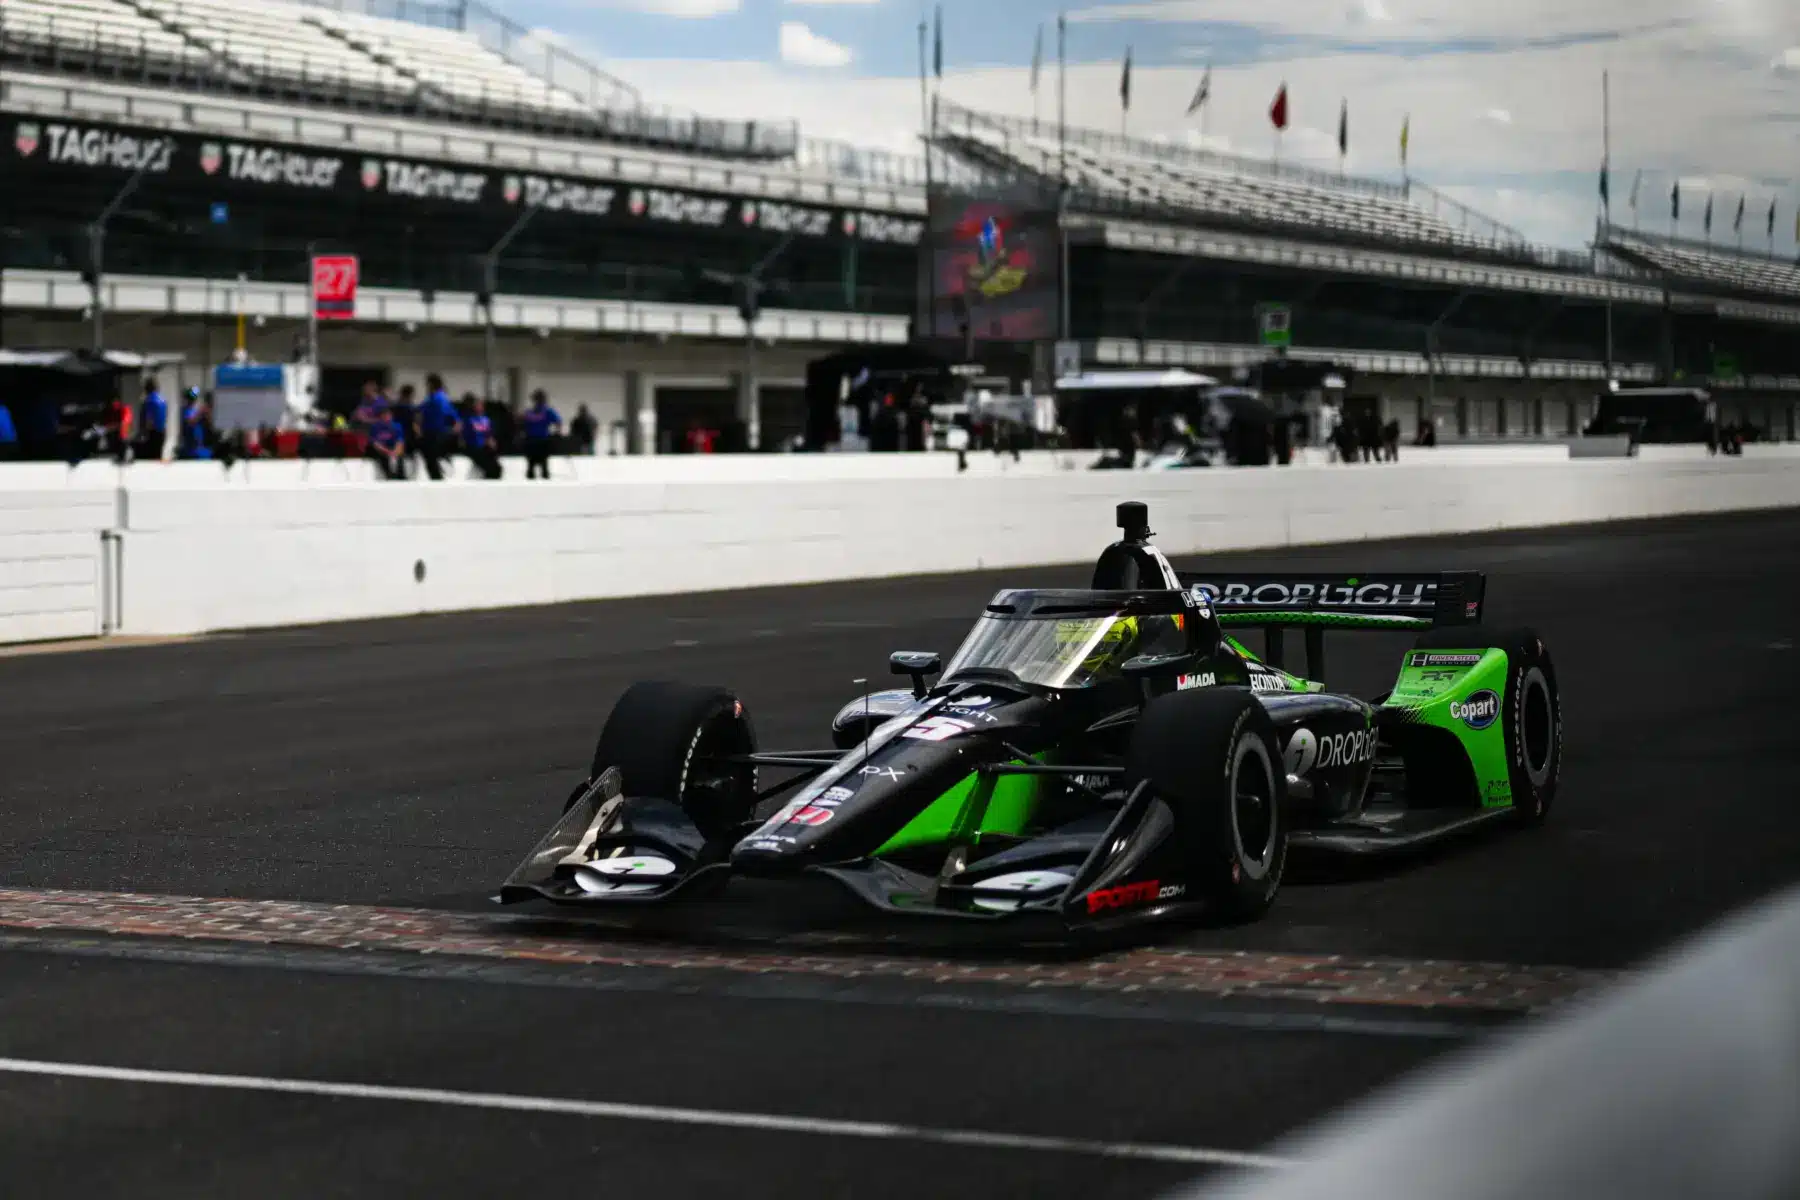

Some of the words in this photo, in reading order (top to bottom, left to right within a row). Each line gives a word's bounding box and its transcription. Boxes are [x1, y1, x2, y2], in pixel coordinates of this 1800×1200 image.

[316, 263, 353, 295] 27
[1191, 578, 1438, 605] DROPLIGH
[1248, 674, 1286, 691] HONDA
[1450, 696, 1494, 721] Copart
[1316, 726, 1379, 768] DROPLIG
